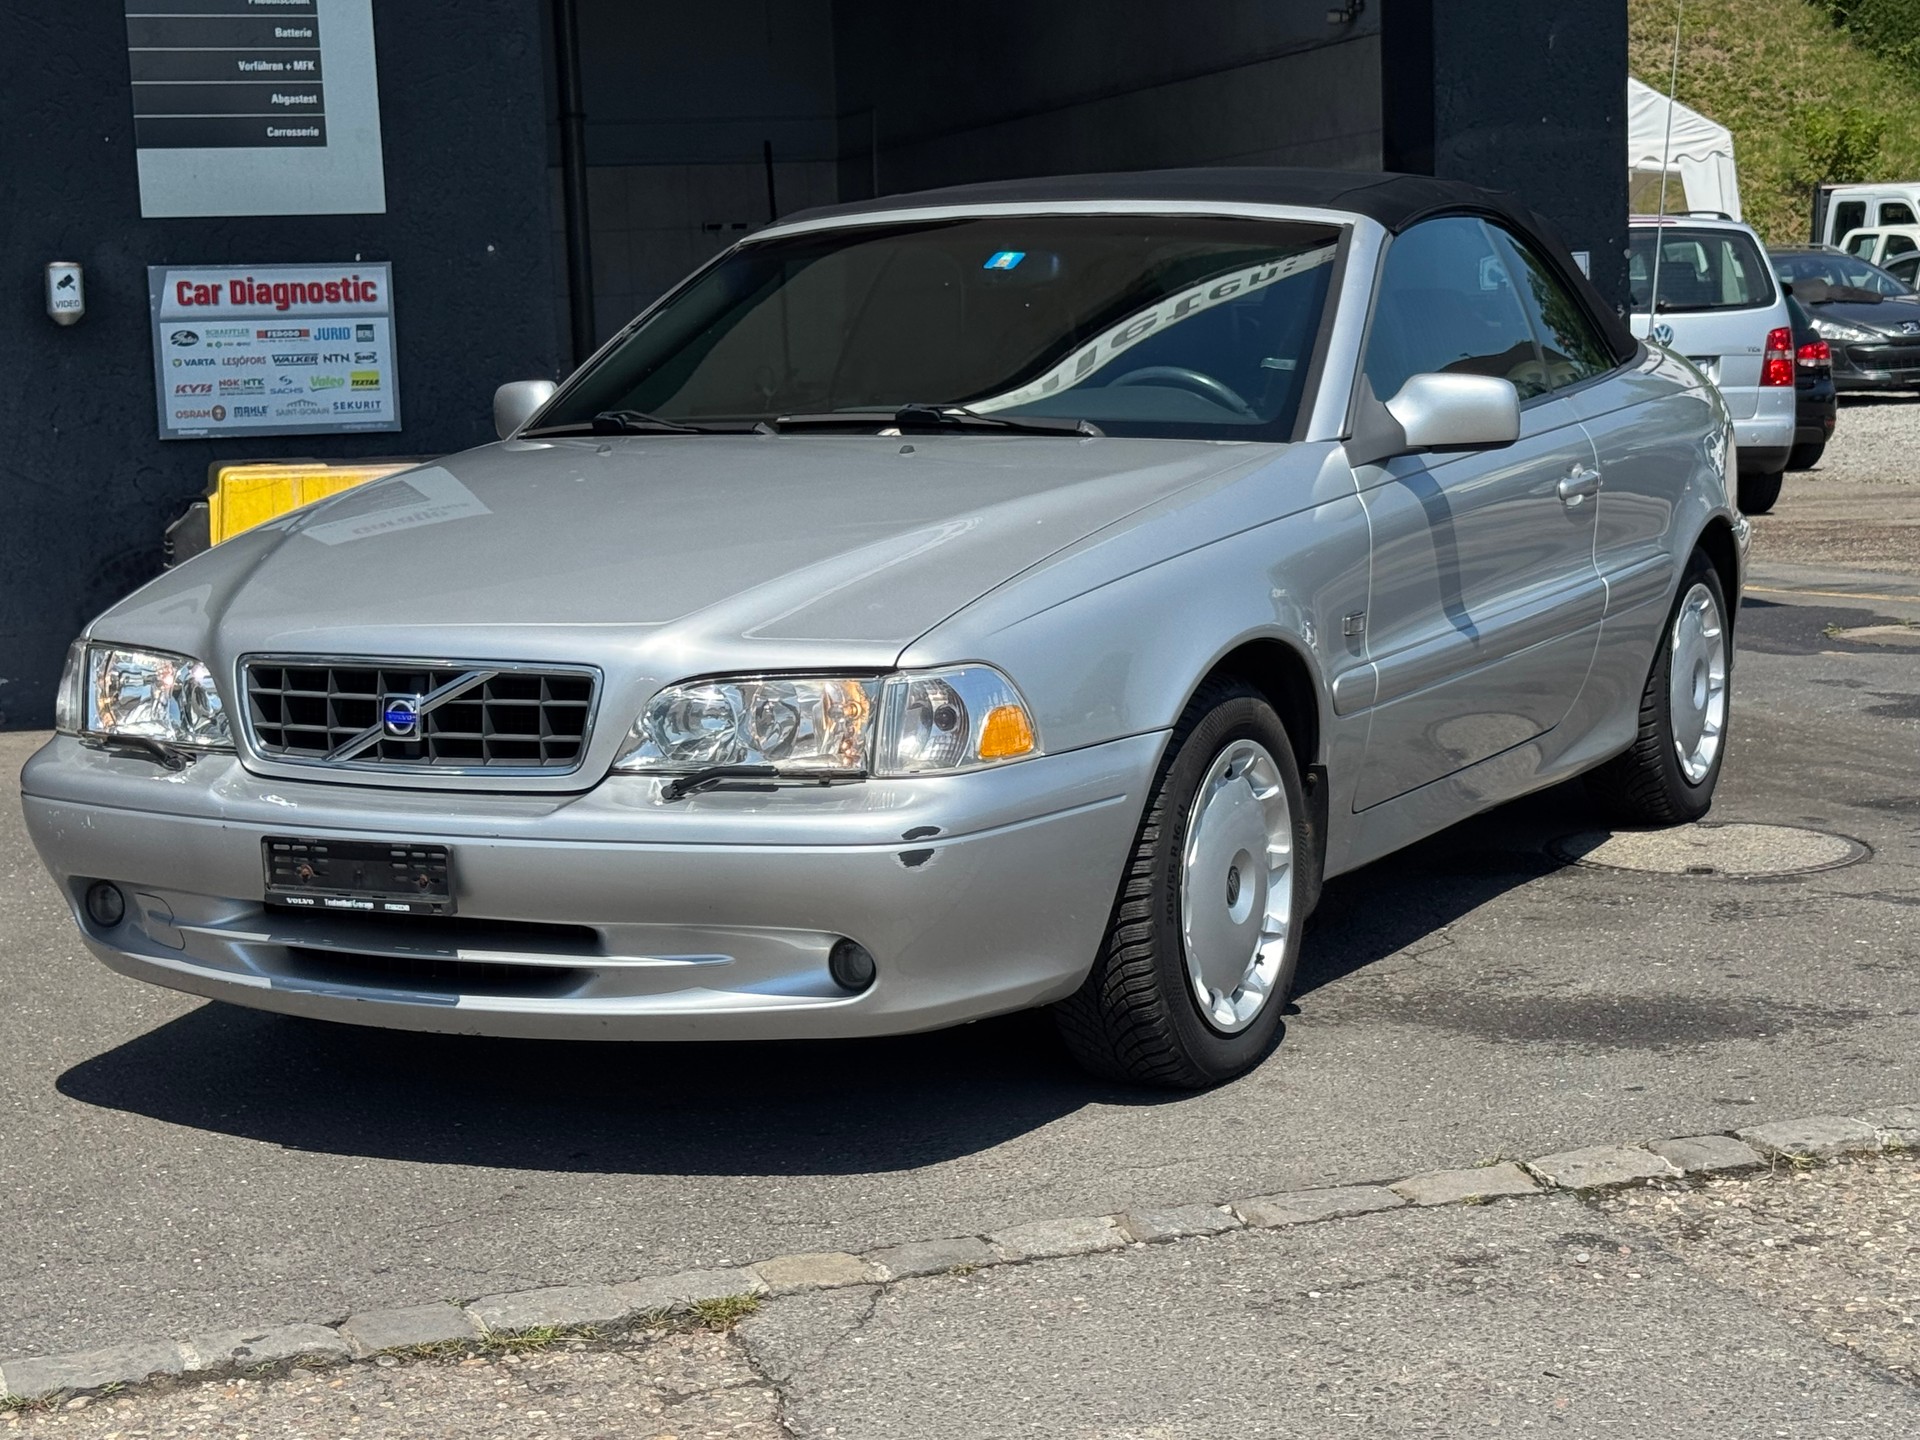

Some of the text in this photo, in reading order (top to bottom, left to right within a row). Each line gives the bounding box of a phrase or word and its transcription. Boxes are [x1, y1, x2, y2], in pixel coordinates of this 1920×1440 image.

[274, 27, 312, 38] Batterie
[238, 60, 283, 71] Vorführen
[293, 60, 315, 71] MFK
[271, 93, 317, 106] Abgastest
[266, 126, 319, 138] Carrosserie
[176, 274, 378, 311] Car Diagnostic
[55, 299, 80, 309] VIDEO
[313, 327, 351, 341] JURID
[184, 358, 216, 367] VARTA
[272, 353, 319, 366] WALKER
[323, 353, 351, 364] NTN
[218, 377, 265, 387] NGK NTK
[175, 383, 213, 394] KYB
[269, 387, 304, 395] SACHS
[233, 405, 268, 415] MAHLE
[333, 400, 382, 410] SEKURIT
[175, 409, 211, 419] OSRAM
[275, 407, 330, 417] SAINT-GOBAIN
[286, 897, 315, 905] VOLVO
